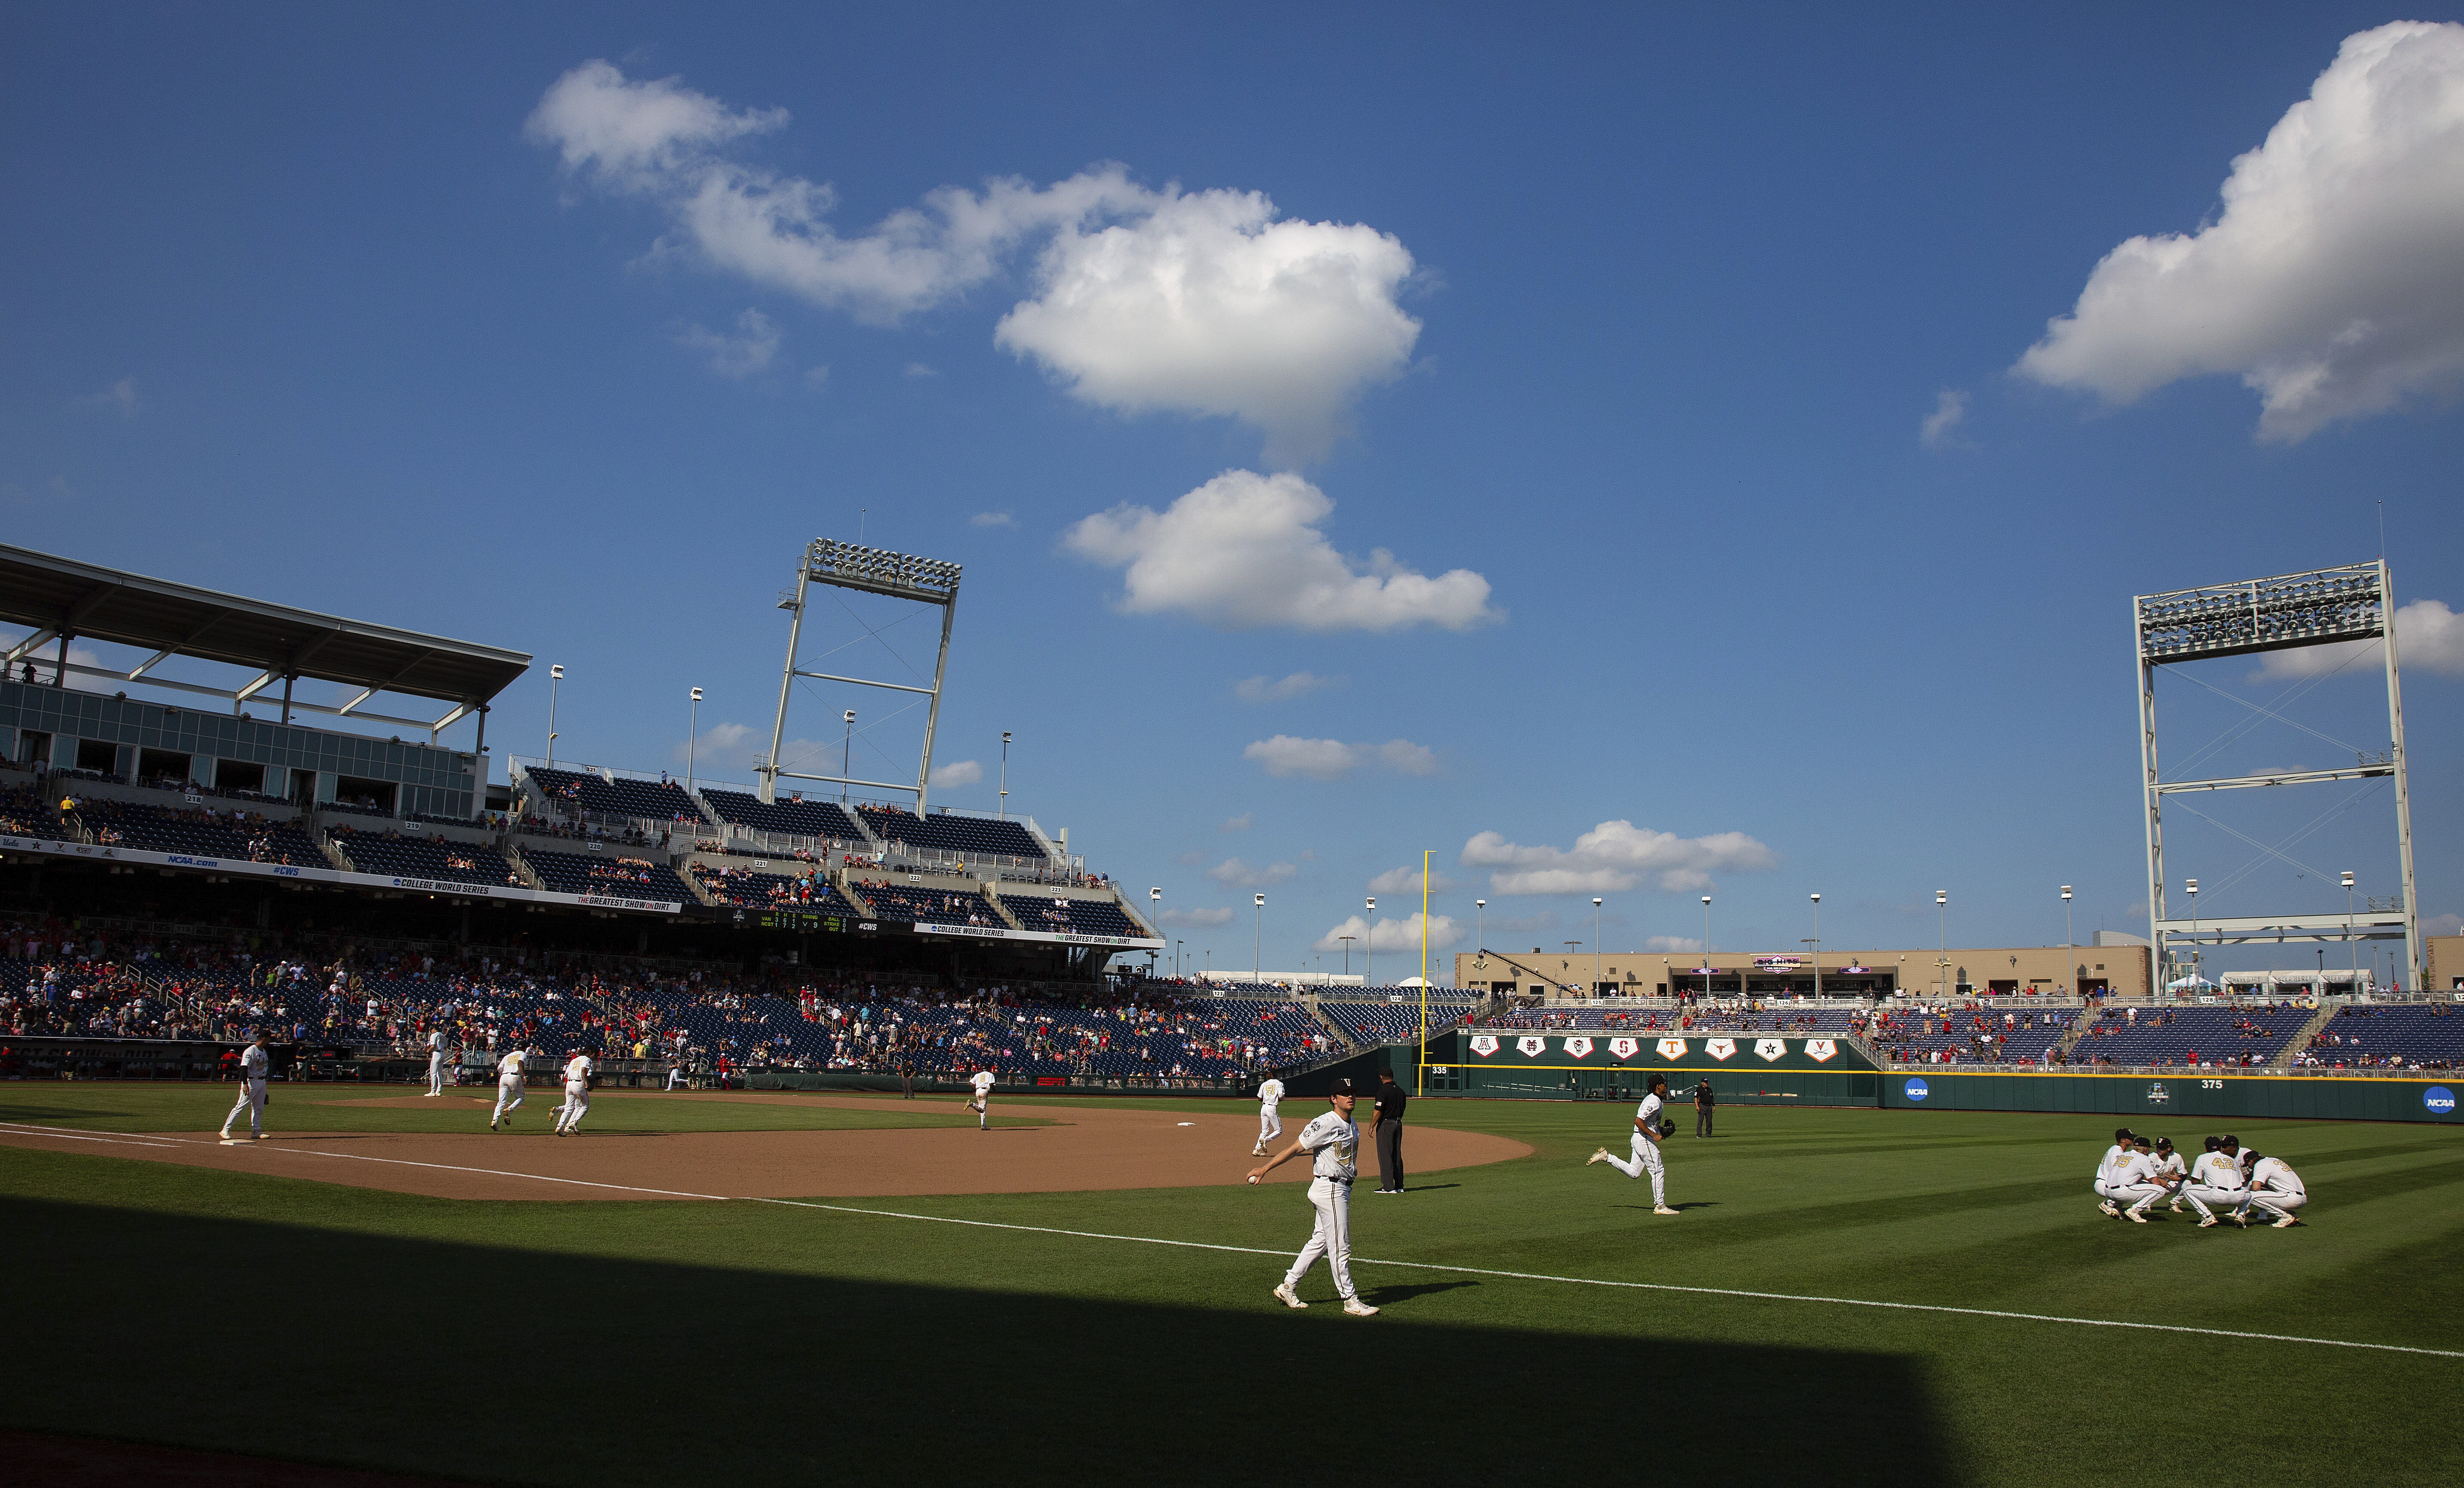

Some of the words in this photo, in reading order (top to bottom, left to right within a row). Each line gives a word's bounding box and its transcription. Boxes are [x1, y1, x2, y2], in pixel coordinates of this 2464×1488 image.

[168, 856, 218, 867] NCAA.com
[274, 866, 299, 876] #CWS
[401, 879, 433, 889] COLLEGE
[435, 882, 461, 892] WORLD
[462, 885, 489, 894] SERIES
[625, 900, 646, 909] SHOW
[1478, 1038, 1490, 1049] A
[1666, 1041, 1678, 1053] T
[1815, 1041, 1825, 1050] V
[508, 1054, 520, 1066] 99
[573, 1061, 580, 1071] 9
[980, 1074, 985, 1082] 2
[1037, 1077, 1065, 1086] ESPN
[1344, 1078, 1351, 1086] V
[1266, 1084, 1275, 1095] 51
[2202, 1080, 2223, 1089] 375
[2212, 1158, 2237, 1171] 42
[2273, 1160, 2292, 1172] 3
